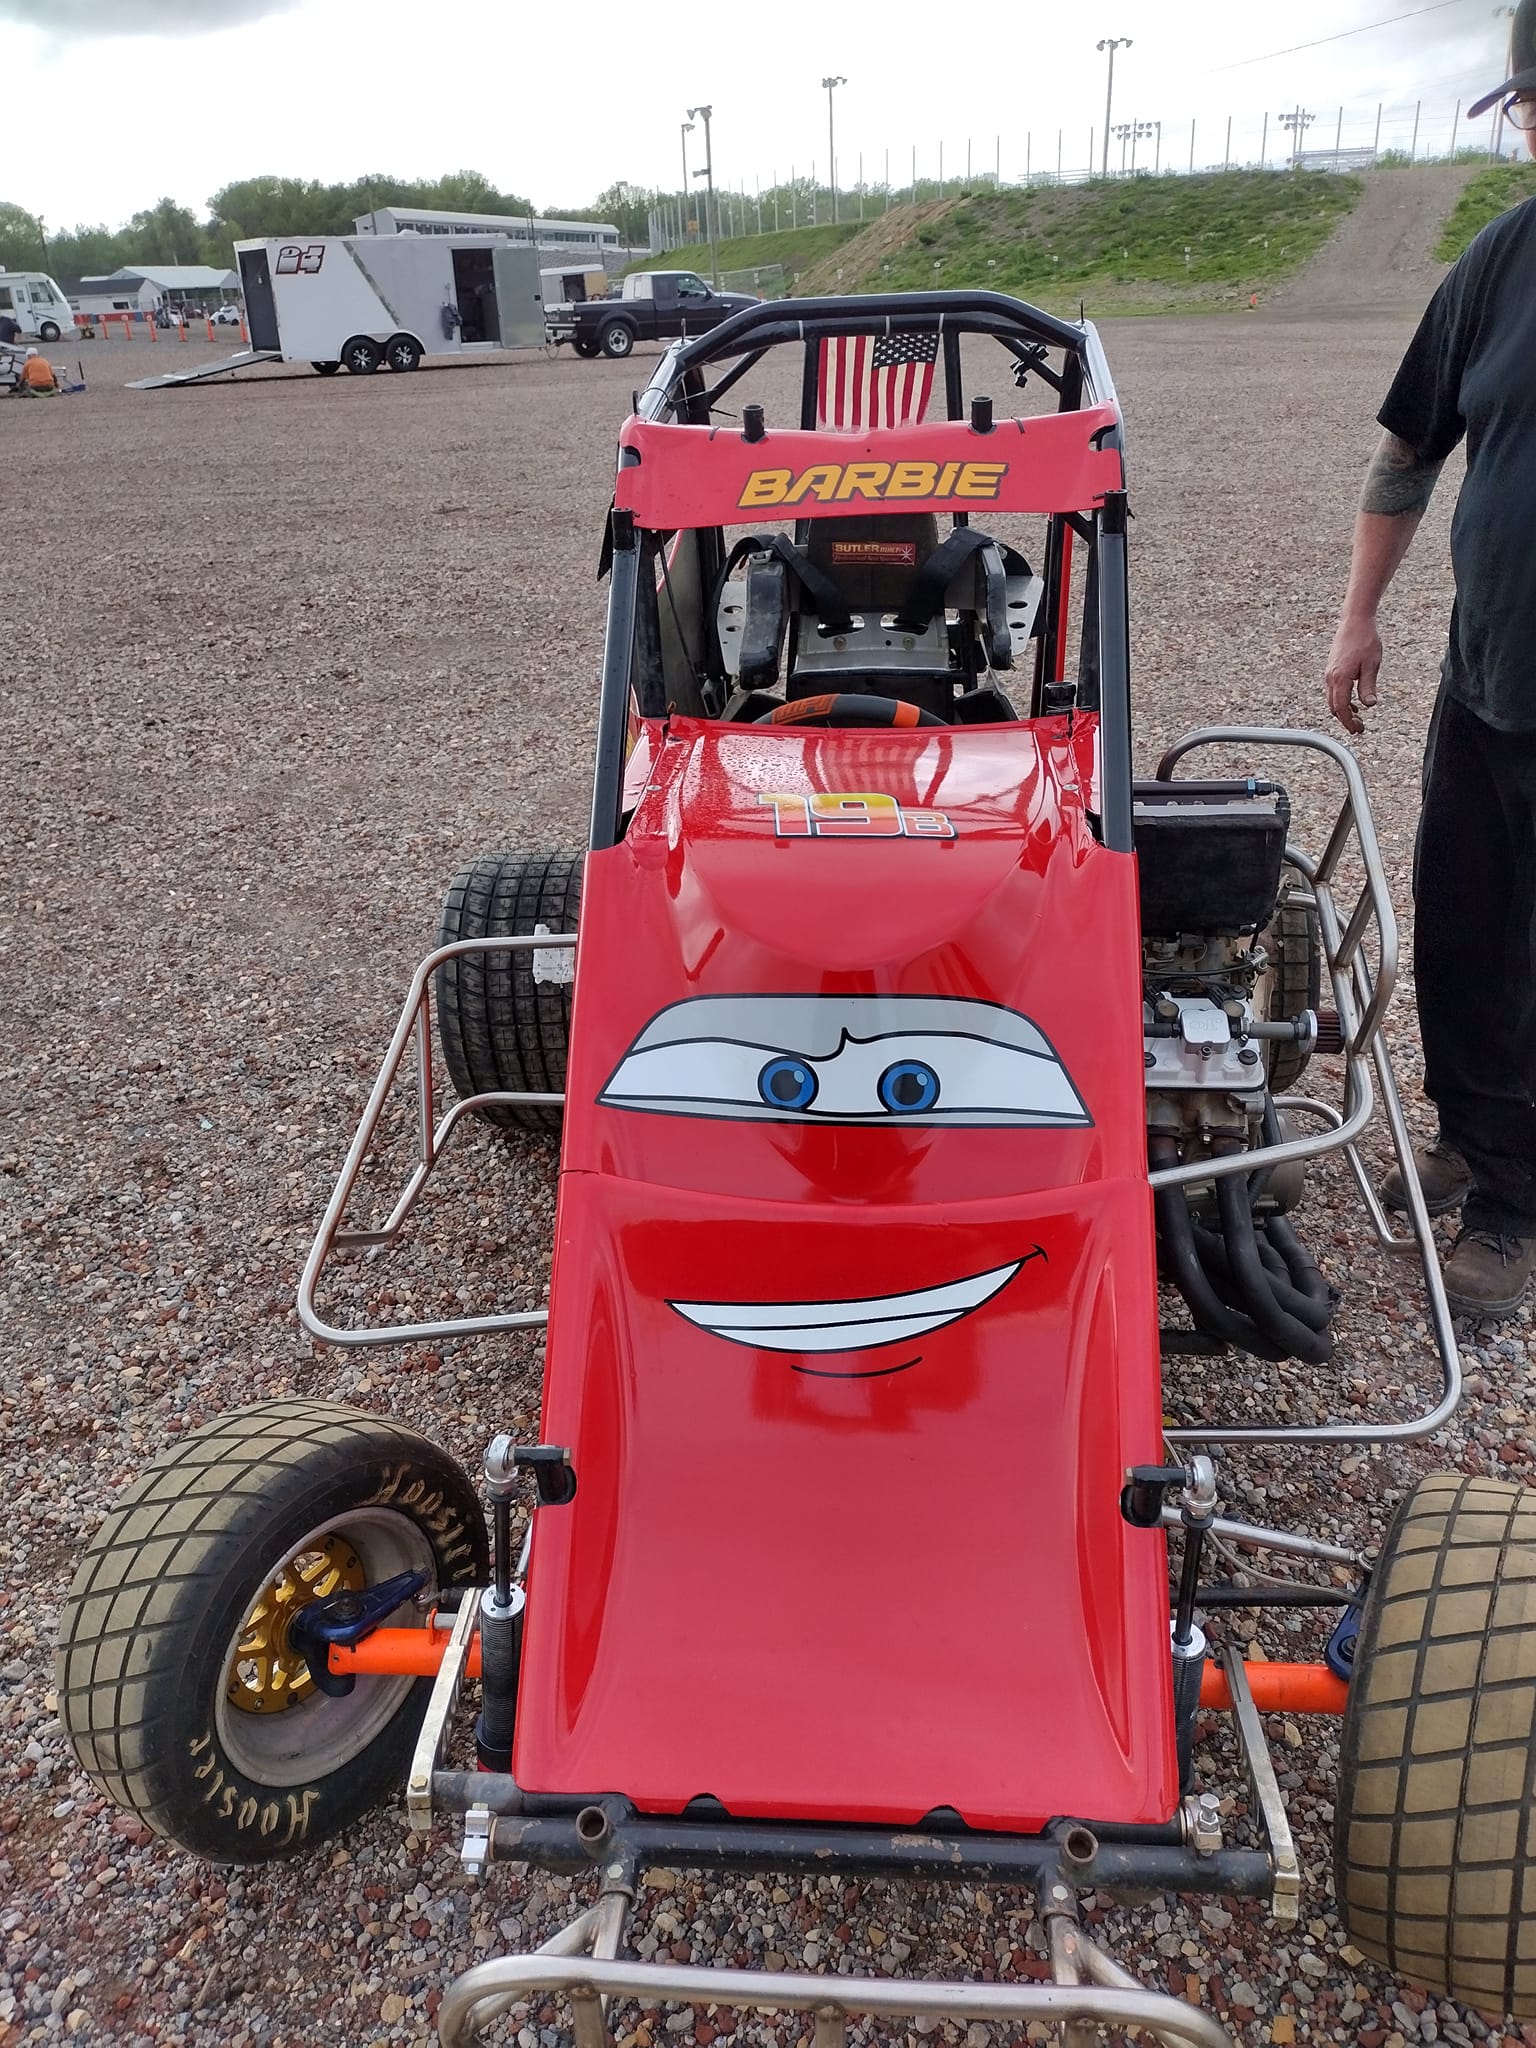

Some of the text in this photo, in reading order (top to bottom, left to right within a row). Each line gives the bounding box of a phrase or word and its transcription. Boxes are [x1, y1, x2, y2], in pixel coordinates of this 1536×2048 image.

[737, 460, 1008, 509] BARBIE
[834, 544, 880, 553] BUTLER
[757, 792, 959, 840] 19B
